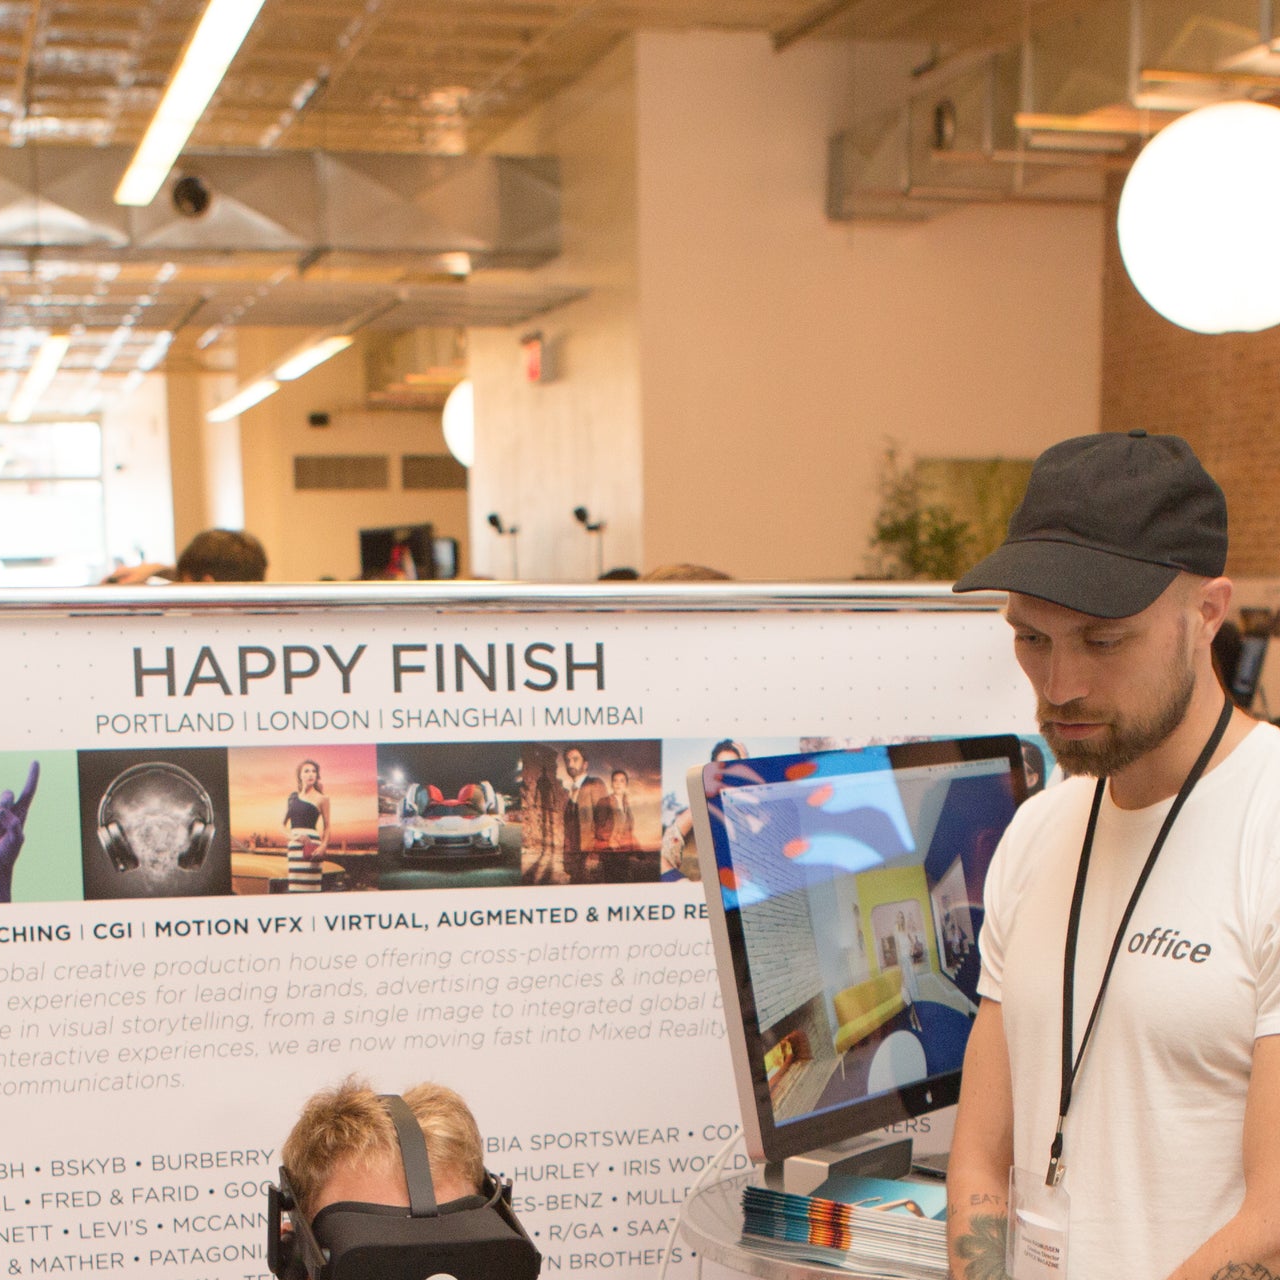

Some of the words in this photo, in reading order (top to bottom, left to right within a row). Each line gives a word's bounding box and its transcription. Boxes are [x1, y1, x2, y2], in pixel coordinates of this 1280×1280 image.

[132, 644, 368, 697] HAPPY
[392, 641, 607, 693] FINISH
[95, 711, 235, 735] PORTLAND
[256, 709, 370, 732] LONDON
[391, 706, 522, 729] SHANGHAI
[543, 705, 643, 727] MUMBAI
[93, 922, 132, 940] CGI
[155, 917, 249, 938] MOTION
[258, 916, 304, 934] VFX
[323, 912, 429, 932] VIRTUAL,
[436, 906, 578, 928] AUGMENTED
[586, 906, 600, 922] &
[607, 903, 677, 922] MIXED
[684, 903, 709, 920] RE
[1127, 926, 1212, 963] office
[53, 960, 145, 981] creative
[153, 955, 280, 980] production
[289, 952, 357, 971] house
[365, 947, 452, 970] offering
[460, 941, 619, 966] cross-platform
[7, 989, 145, 1013] experiences
[156, 983, 186, 1005] for
[194, 981, 278, 1004] leading
[286, 977, 367, 1000] brands,
[376, 975, 499, 996] advertising
[506, 972, 602, 994] agencies
[610, 966, 624, 987] &
[20, 1022, 39, 1038] in
[49, 1015, 113, 1038] visual
[122, 1010, 253, 1036] storytelling,
[264, 1007, 314, 1028] from
[322, 1010, 335, 1026] a
[343, 1004, 408, 1028] single
[417, 1003, 483, 1024] image
[492, 1001, 513, 1019] to
[521, 994, 633, 1020] integrated
[640, 991, 705, 1017] global
[117, 1040, 258, 1065] experiences,
[268, 1039, 299, 1055] we
[306, 1037, 341, 1054] are
[349, 1035, 395, 1052] now
[404, 1031, 485, 1051] moving
[494, 1025, 532, 1046] fast
[540, 1025, 580, 1043] into
[589, 1020, 652, 1041] Mixed
[659, 1019, 731, 1040] Reality
[50, 1156, 127, 1177] BSKYB
[151, 1148, 274, 1172] BURBERRY
[529, 1126, 680, 1151] SPORTSWEAR
[40, 1189, 102, 1209] FRED
[108, 1188, 124, 1206] &
[131, 1184, 199, 1204] FARID
[514, 1161, 600, 1184] HURLEY
[623, 1160, 663, 1177] IRIS
[78, 1218, 148, 1240] LEVI'S
[172, 1211, 268, 1236] MCCANN
[7, 1257, 22, 1276] &
[29, 1251, 124, 1274] MATHER
[149, 1243, 262, 1266] PATAGONI
[548, 1222, 604, 1242] R/GA
